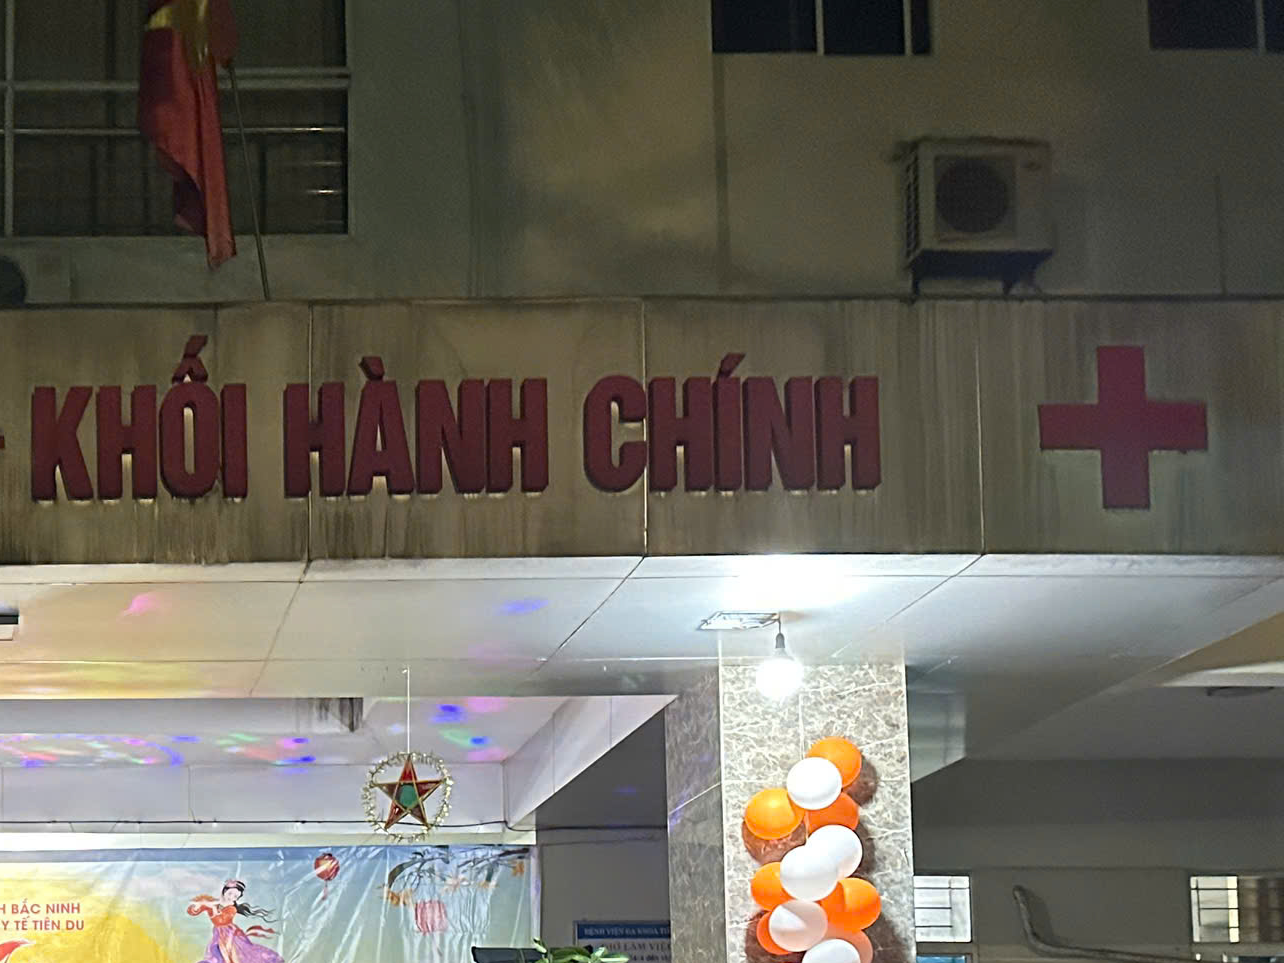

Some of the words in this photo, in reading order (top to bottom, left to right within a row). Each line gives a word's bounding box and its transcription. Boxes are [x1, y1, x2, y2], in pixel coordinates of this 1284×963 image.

[30, 334, 248, 502] KHỐI
[283, 354, 550, 499] HÀNH
[583, 352, 880, 497] CHÍNH
[11, 899, 41, 914] BẮC
[46, 903, 81, 914] NINH
[1, 920, 10, 931] Y
[14, 916, 30, 931] TẾ
[32, 918, 61, 931] TIÊN
[66, 920, 85, 931] DU
